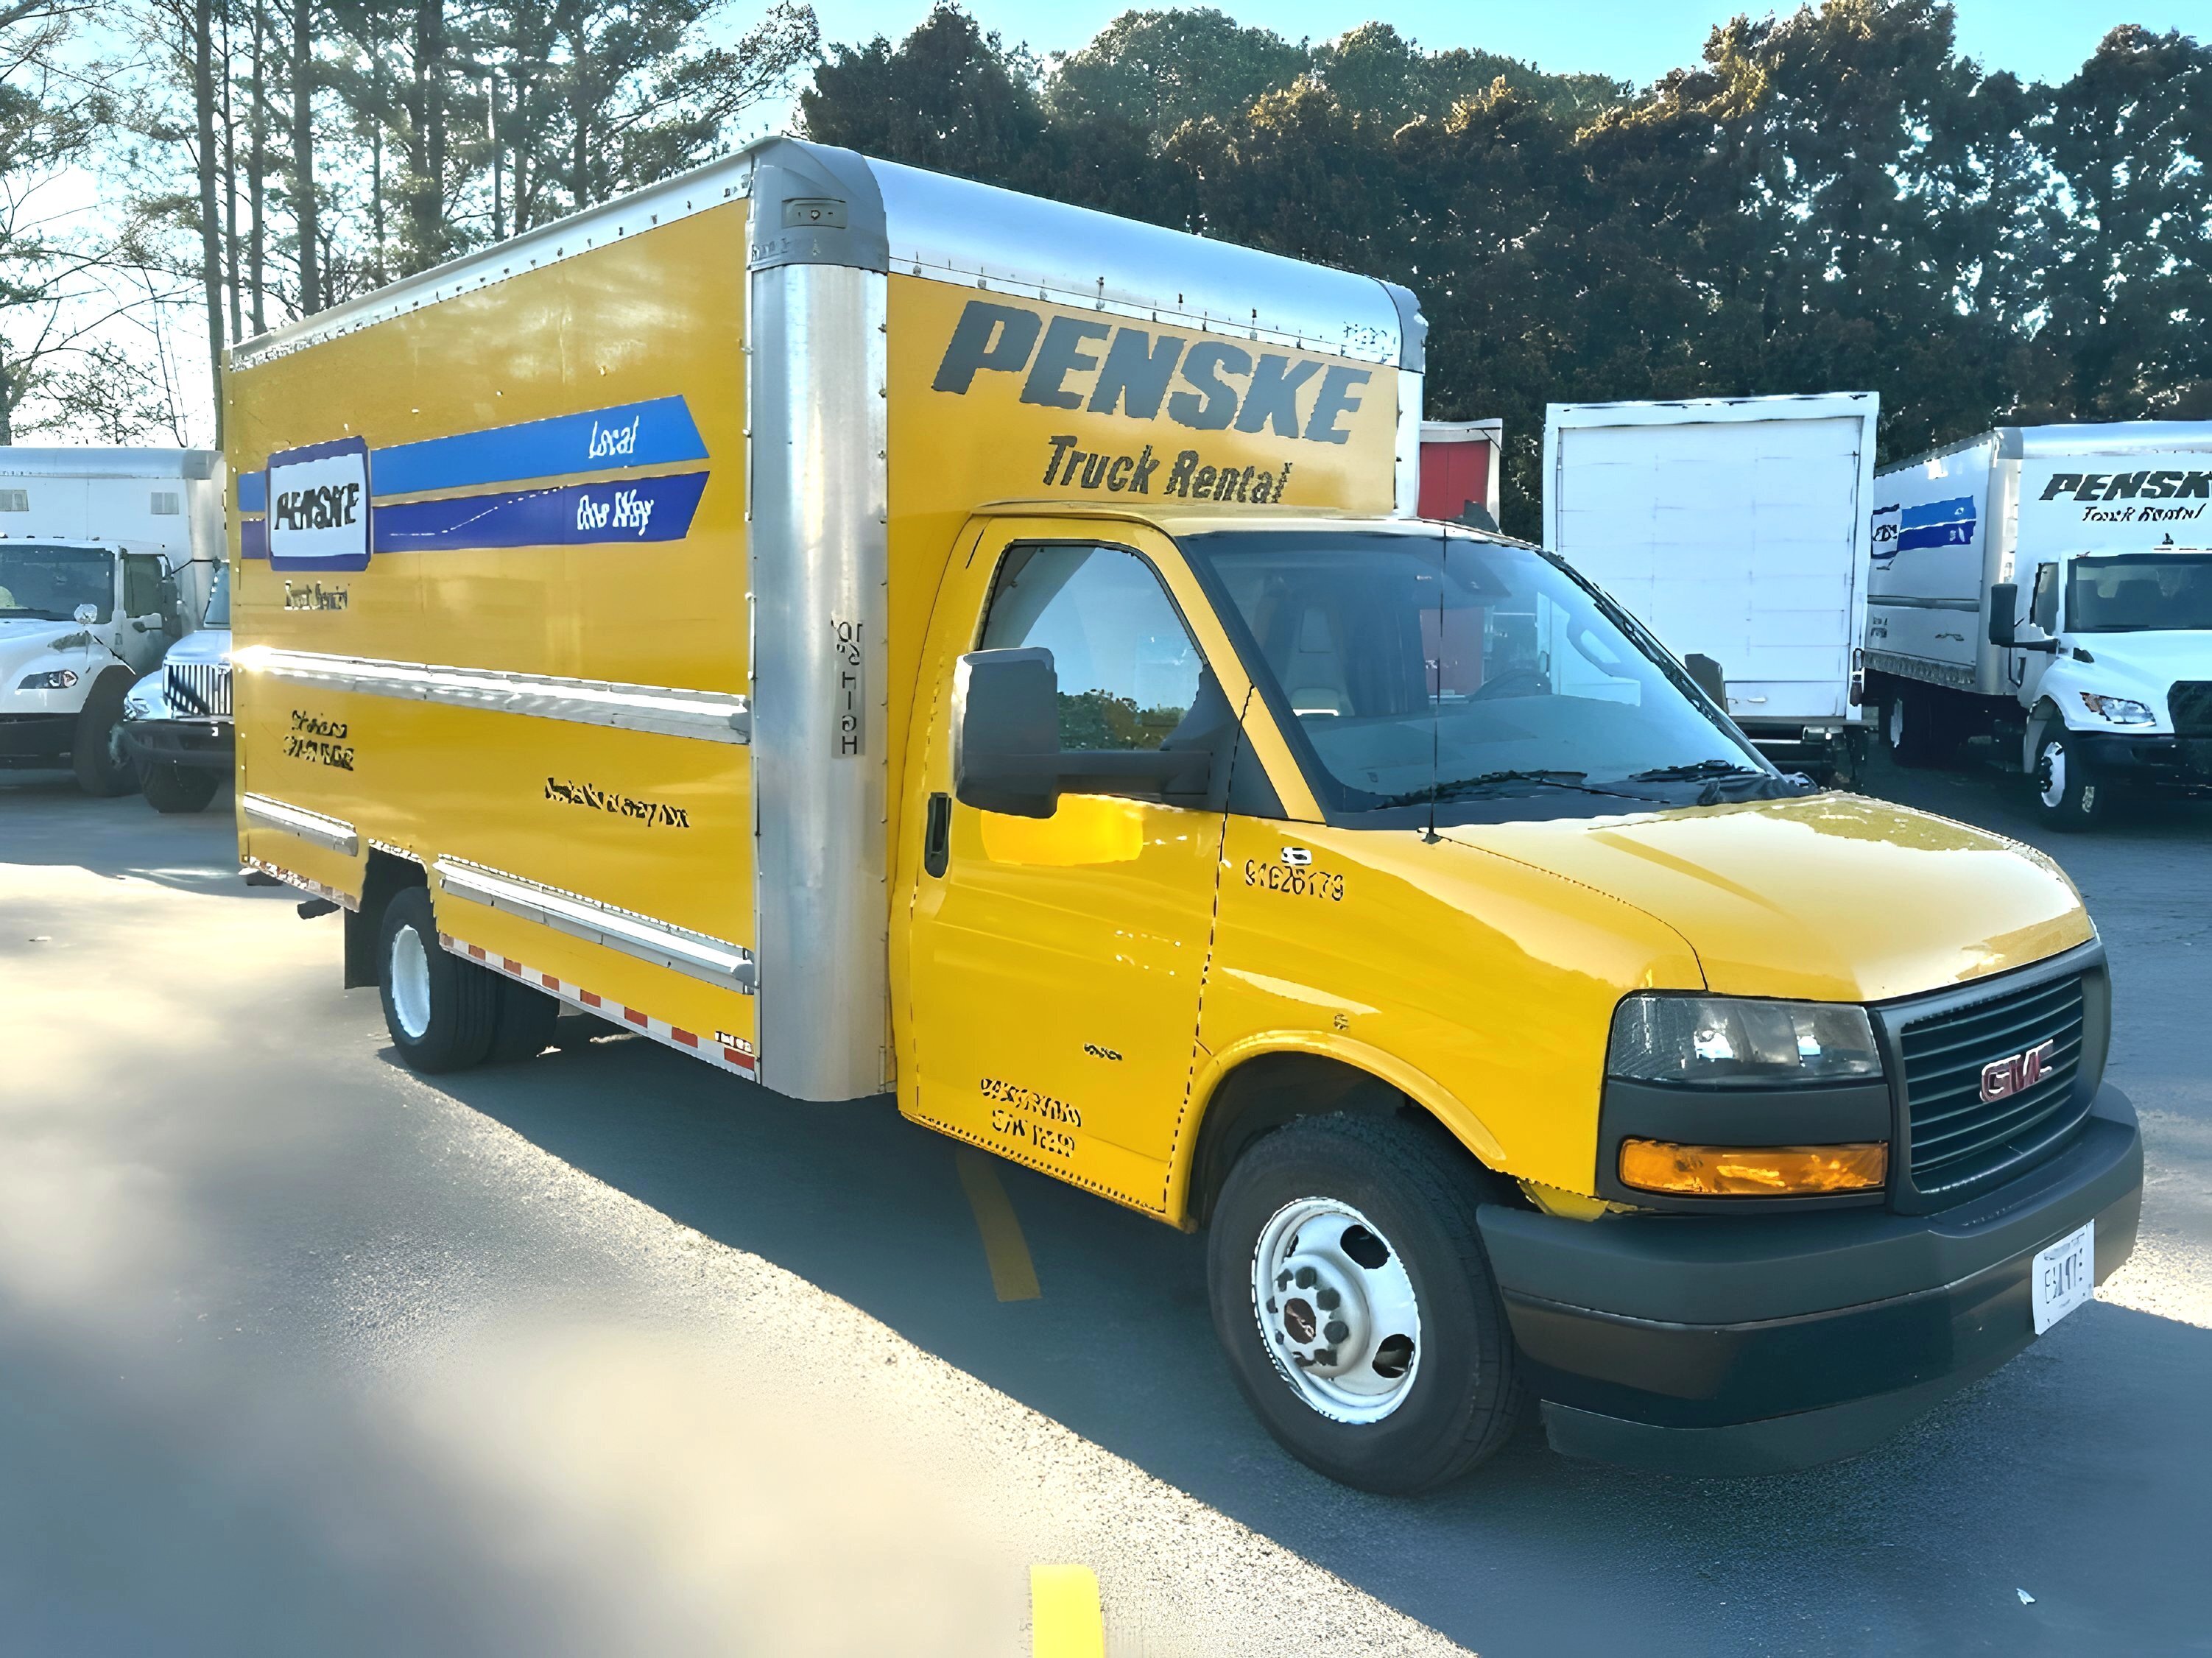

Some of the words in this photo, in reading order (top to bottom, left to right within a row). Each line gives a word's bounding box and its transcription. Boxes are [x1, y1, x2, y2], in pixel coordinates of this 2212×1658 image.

[931, 300, 1372, 445] PENSKE
[1043, 435, 1160, 495] Truck
[1163, 450, 1293, 504] Rental
[2038, 470, 2212, 501] PENSK
